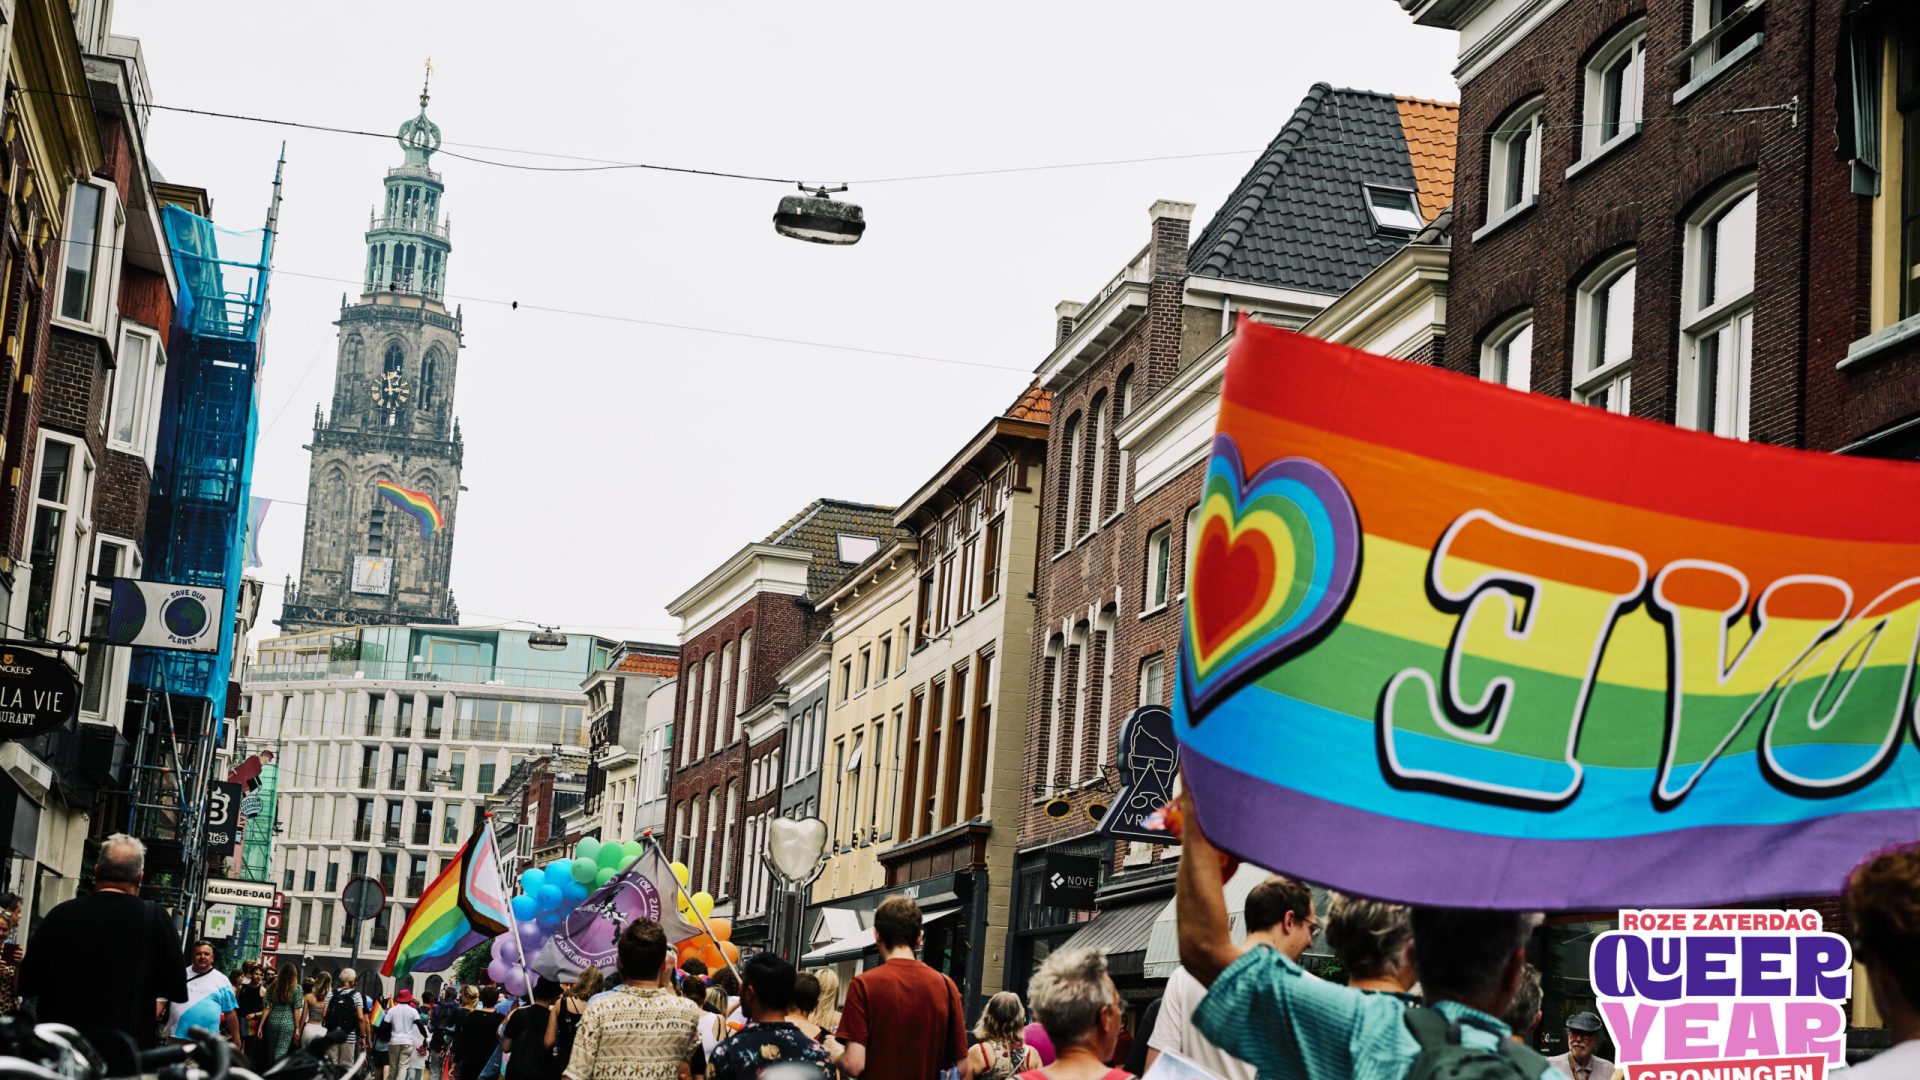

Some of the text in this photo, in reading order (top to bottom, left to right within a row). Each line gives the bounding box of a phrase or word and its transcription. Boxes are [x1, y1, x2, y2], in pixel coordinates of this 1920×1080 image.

[170, 589, 206, 602] SAVE OUR
[168, 634, 197, 645] PLANET
[0, 686, 64, 713] LA VIE
[0, 711, 36, 726] URANT
[1067, 875, 1095, 887] NOVE
